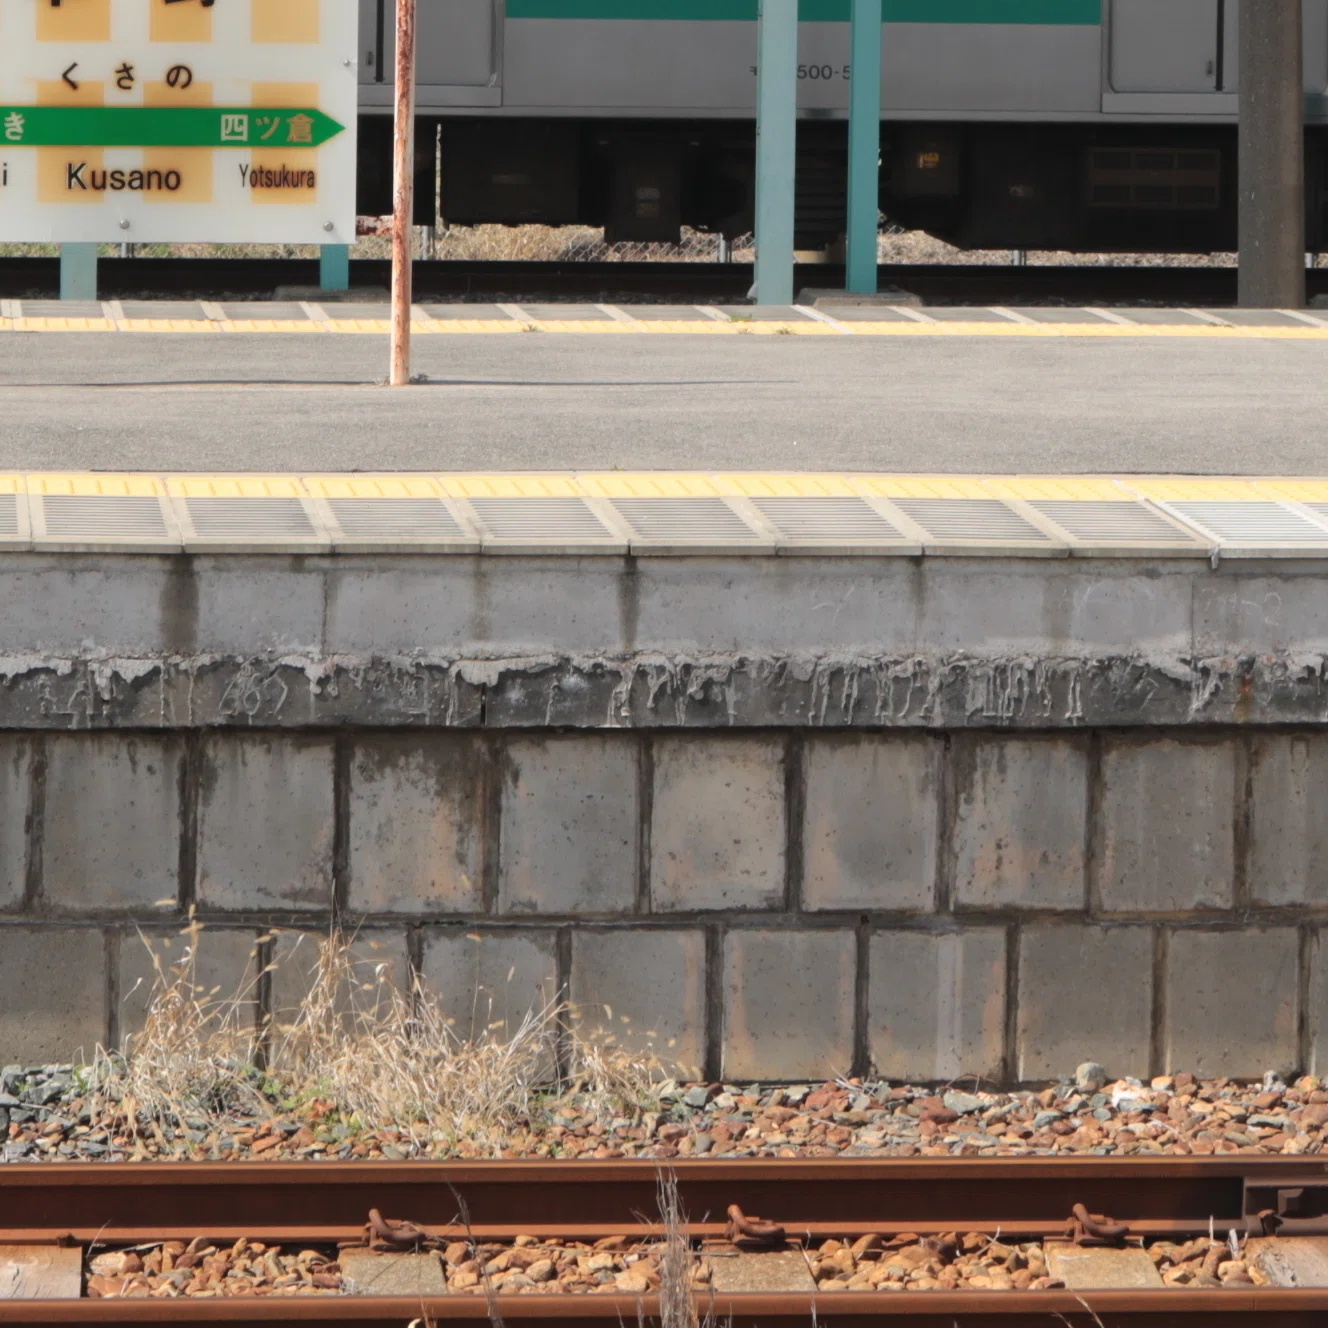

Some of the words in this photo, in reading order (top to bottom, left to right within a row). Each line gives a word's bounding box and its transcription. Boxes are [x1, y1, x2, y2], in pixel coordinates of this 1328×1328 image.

[61, 62, 193, 91] くさの
[220, 113, 314, 144] 四ツ倉
[67, 163, 181, 192] Kusano
[239, 163, 315, 190] Yotsukura
